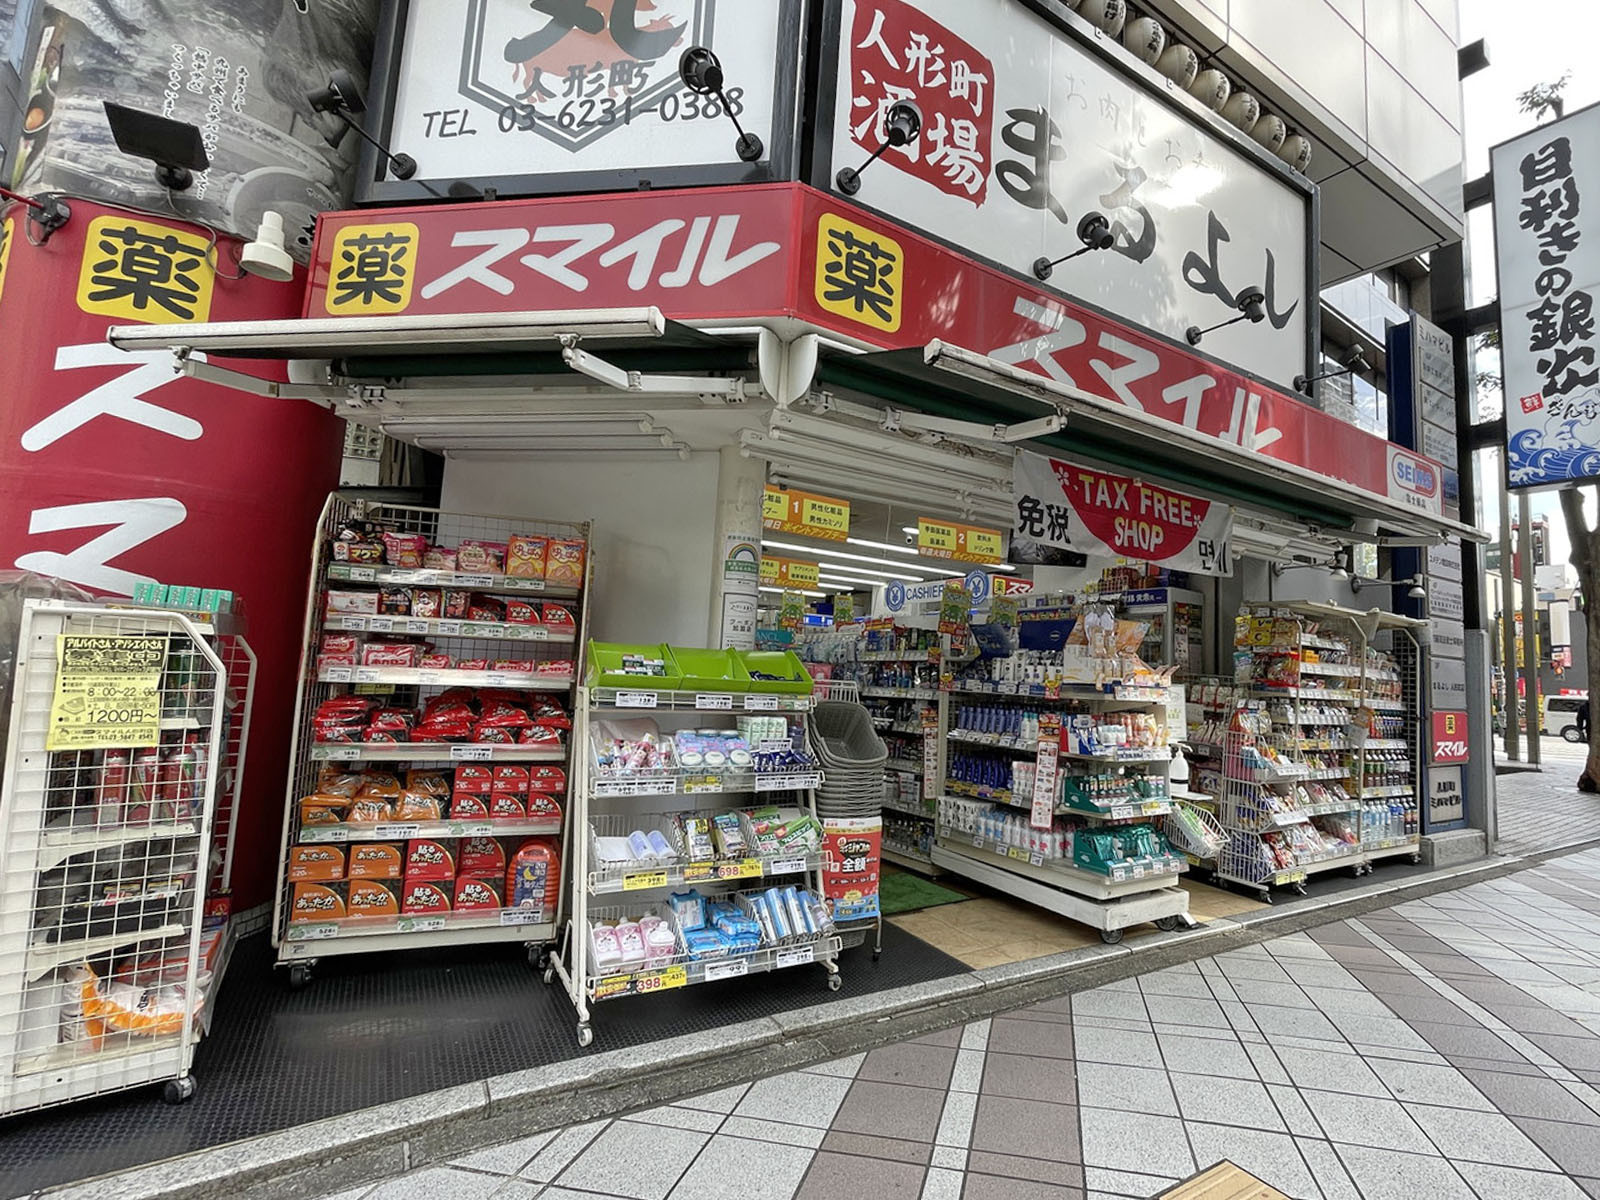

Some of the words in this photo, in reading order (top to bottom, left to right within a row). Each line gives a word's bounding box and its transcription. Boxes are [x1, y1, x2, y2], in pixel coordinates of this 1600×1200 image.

[857, 8, 989, 118] 人形町
[514, 61, 656, 100] 人形町
[423, 109, 477, 138] TEL
[497, 87, 745, 134] 03-6231-0388
[420, 213, 781, 300] スマイル
[87, 226, 207, 320] 薬
[334, 231, 412, 305] 薬
[824, 228, 897, 323] 薬
[1519, 137, 1600, 399] 目利きの銀次
[988, 296, 1283, 452] スマイル
[1396, 461, 1433, 490] SEIMS
[792, 500, 799, 514] 1
[1078, 474, 1130, 511] TAX
[1140, 486, 1193, 528] FREE
[1017, 494, 1072, 544] 免税
[958, 532, 965, 545] 2
[1113, 516, 1164, 553] SHOP
[1006, 581, 1033, 595] スマ
[1434, 741, 1468, 757] スマイル
[410, 852, 443, 862] あったか
[417, 845, 436, 855] 貼る
[841, 857, 867, 873] 全額
[351, 893, 388, 905] あったか
[406, 895, 440, 905] あったか
[413, 887, 432, 897] 貼る
[458, 892, 490, 903] あったか
[465, 884, 482, 894] 貼る
[296, 896, 335, 908] あったか
